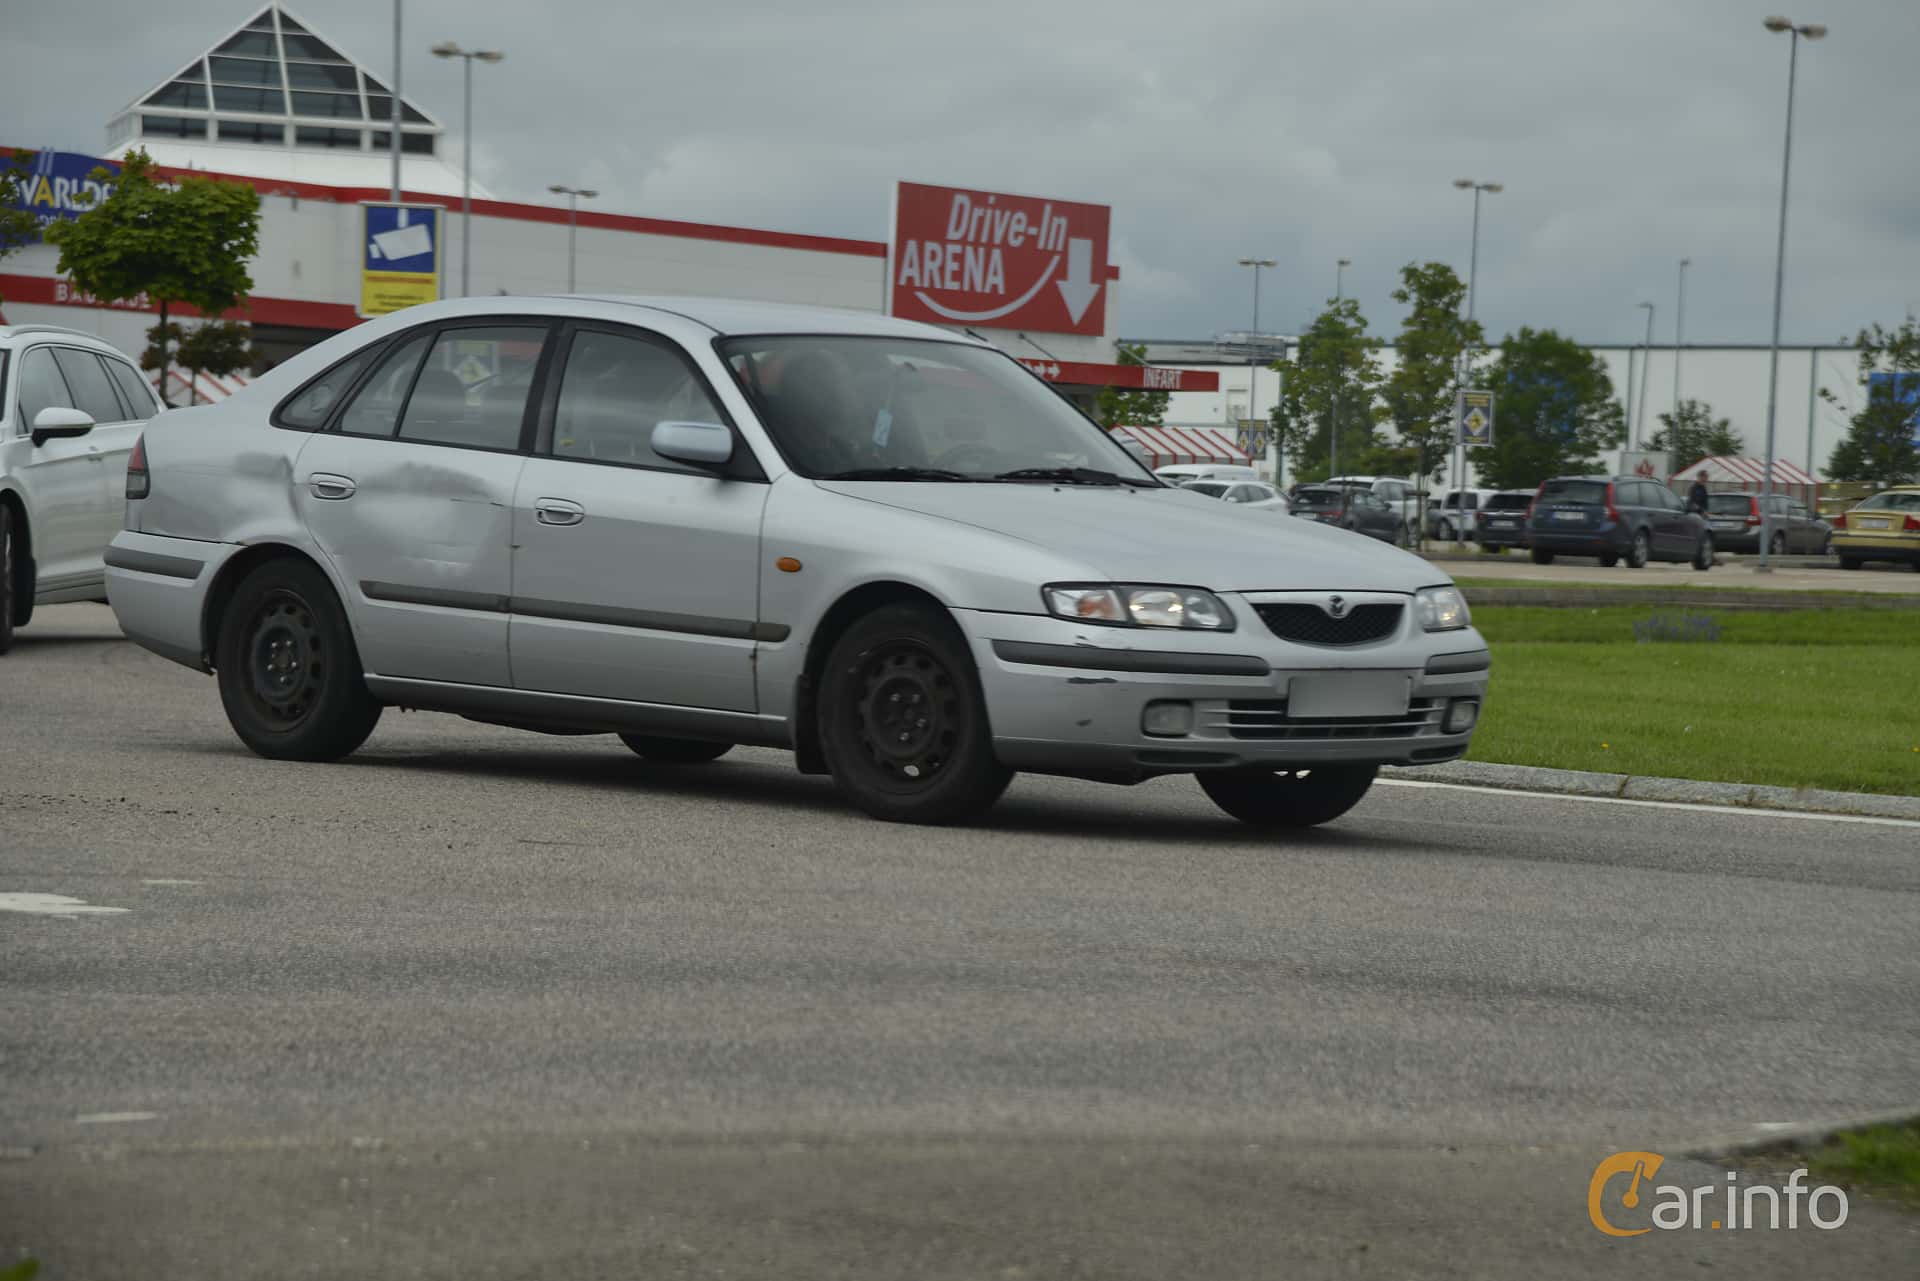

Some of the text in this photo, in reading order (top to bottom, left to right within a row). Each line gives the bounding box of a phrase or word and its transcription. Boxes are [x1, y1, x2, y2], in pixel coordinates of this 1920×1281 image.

[945, 193, 1069, 252] Drive-In
[897, 239, 1006, 296] ARENA
[1143, 367, 1184, 390] INFART
